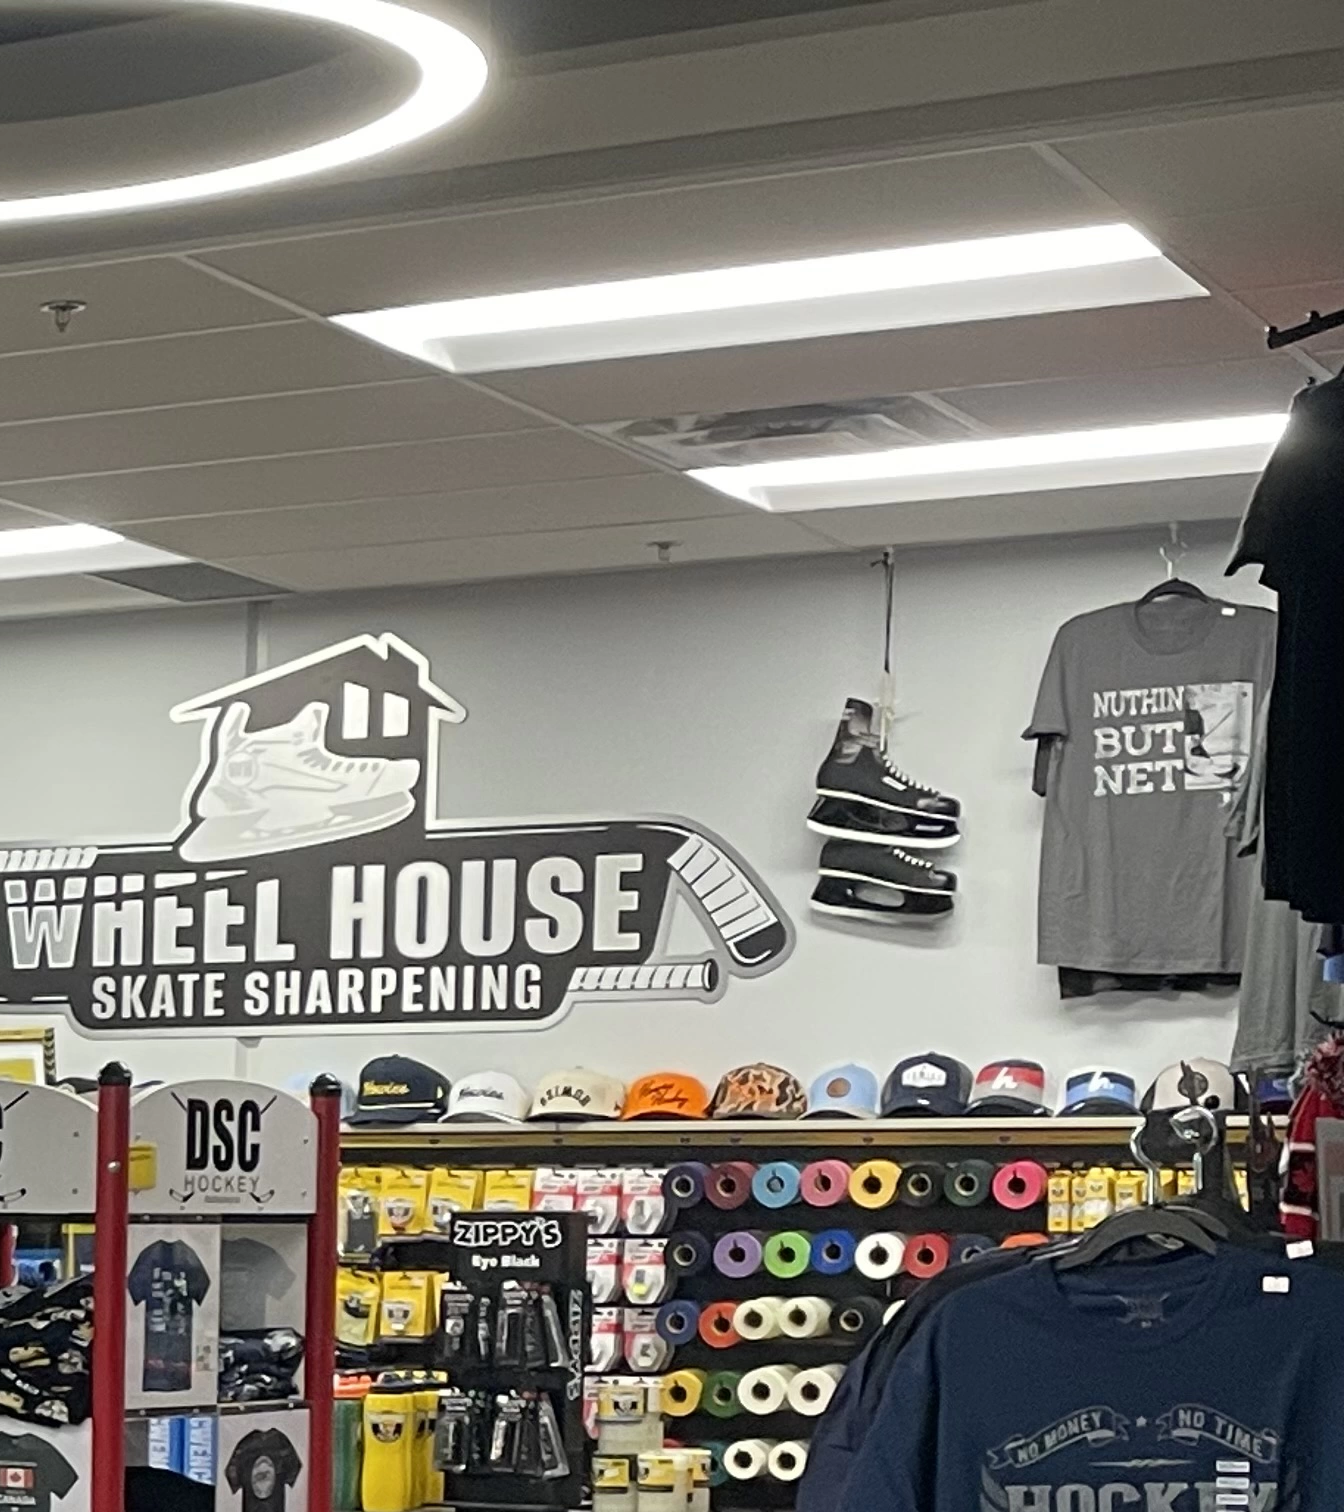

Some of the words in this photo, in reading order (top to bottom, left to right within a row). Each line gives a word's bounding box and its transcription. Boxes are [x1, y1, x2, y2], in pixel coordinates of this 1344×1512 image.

[1092, 685, 1186, 719] NUTHIN
[1092, 720, 1186, 760] BUT
[1092, 758, 1185, 798] NET
[3, 866, 296, 970] WHEEL
[329, 851, 645, 966] HOUSE
[91, 970, 227, 1023] SKATE
[242, 963, 542, 1017] SHARPENING
[187, 1097, 262, 1173] DSC
[184, 1174, 259, 1195] HOCKEY
[453, 1219, 562, 1249] ZIPPY'S
[471, 1253, 499, 1271] Eye
[500, 1254, 540, 1268] Black
[1017, 1441, 1040, 1464] NO
[1043, 1411, 1105, 1451] MONEY
[1178, 1409, 1205, 1428] NO
[1214, 1417, 1264, 1457] TIME
